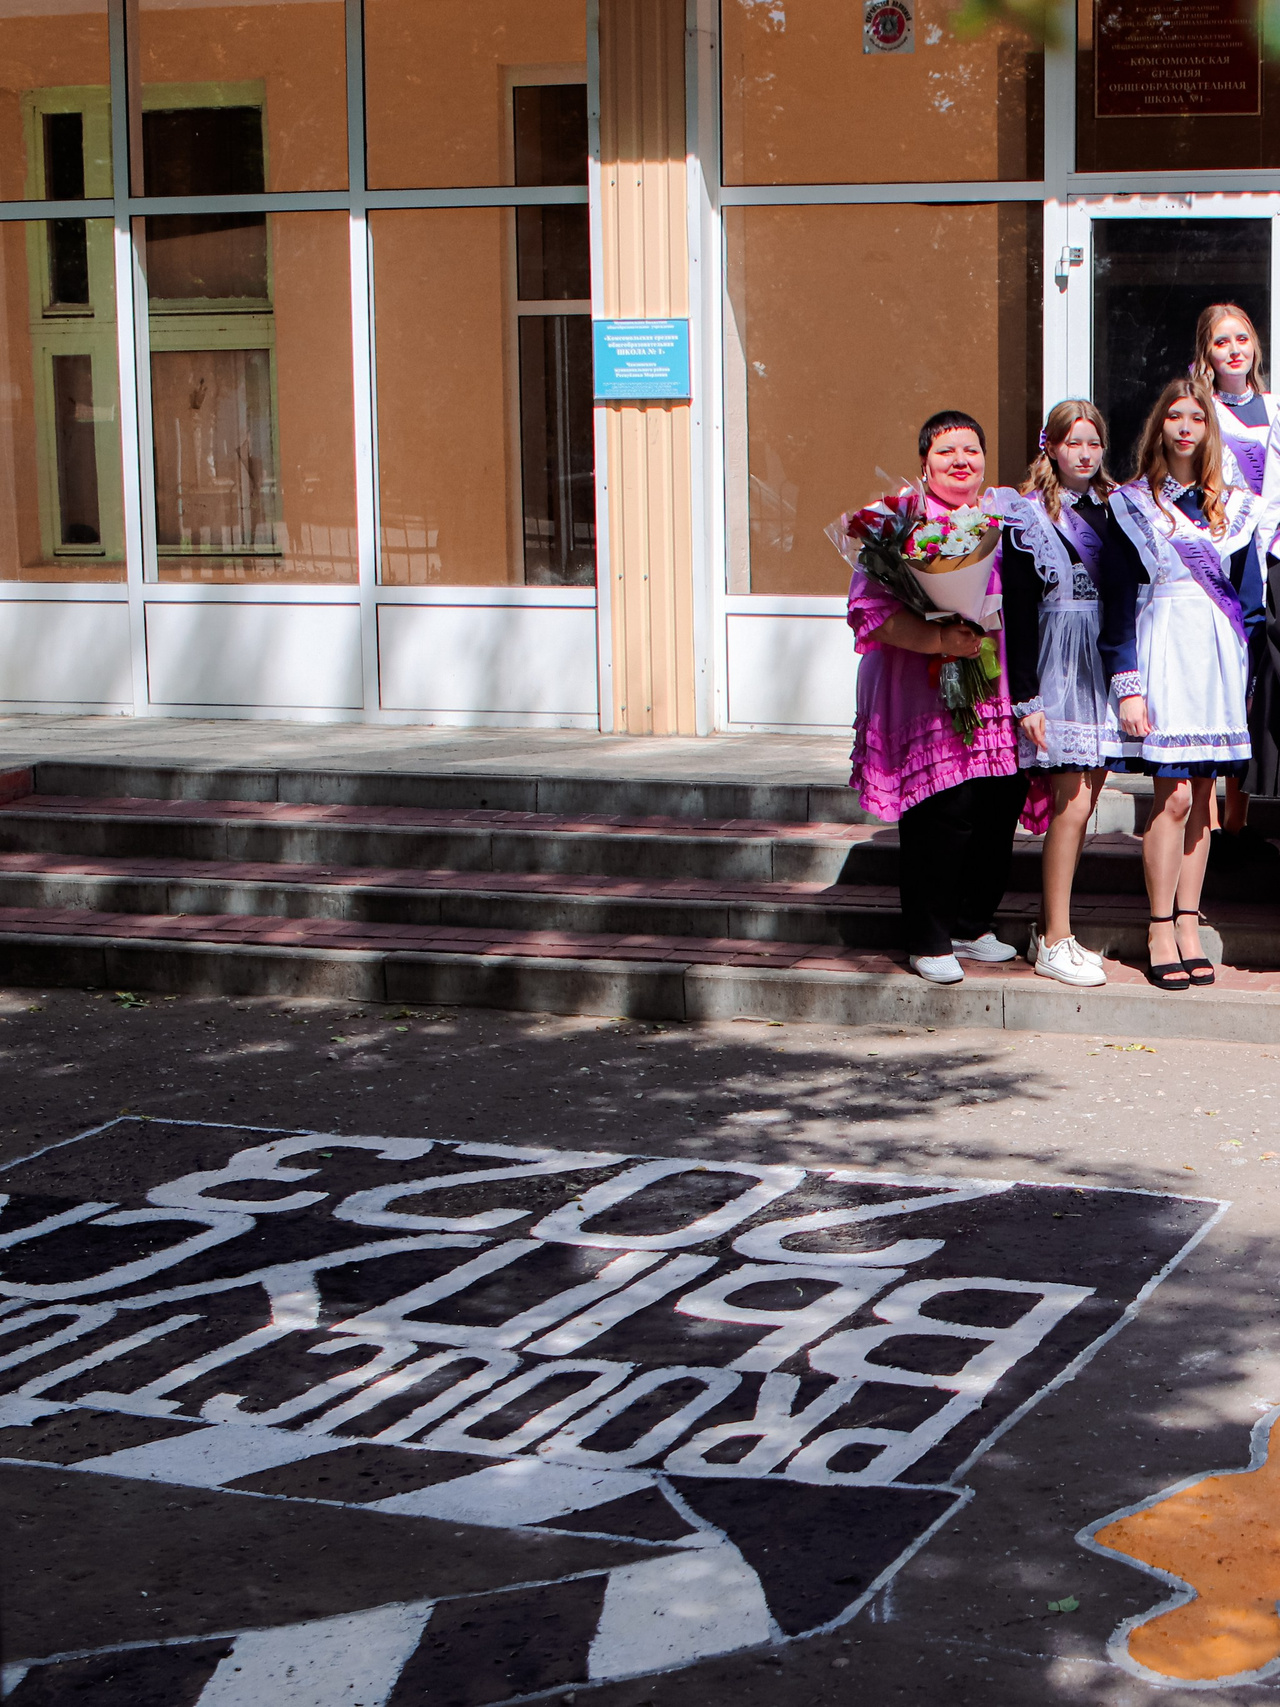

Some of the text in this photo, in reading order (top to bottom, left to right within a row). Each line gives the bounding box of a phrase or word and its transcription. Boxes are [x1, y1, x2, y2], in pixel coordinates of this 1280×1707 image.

[1152, 69, 1201, 79] СРЕДНЯЯ
[1109, 81, 1247, 92] ОБЩЕОБРАЗОВАТЕЛЬНАЯ
[1144, 95, 1184, 104] ШКОЛА
[147, 1135, 1017, 1267] 2023
